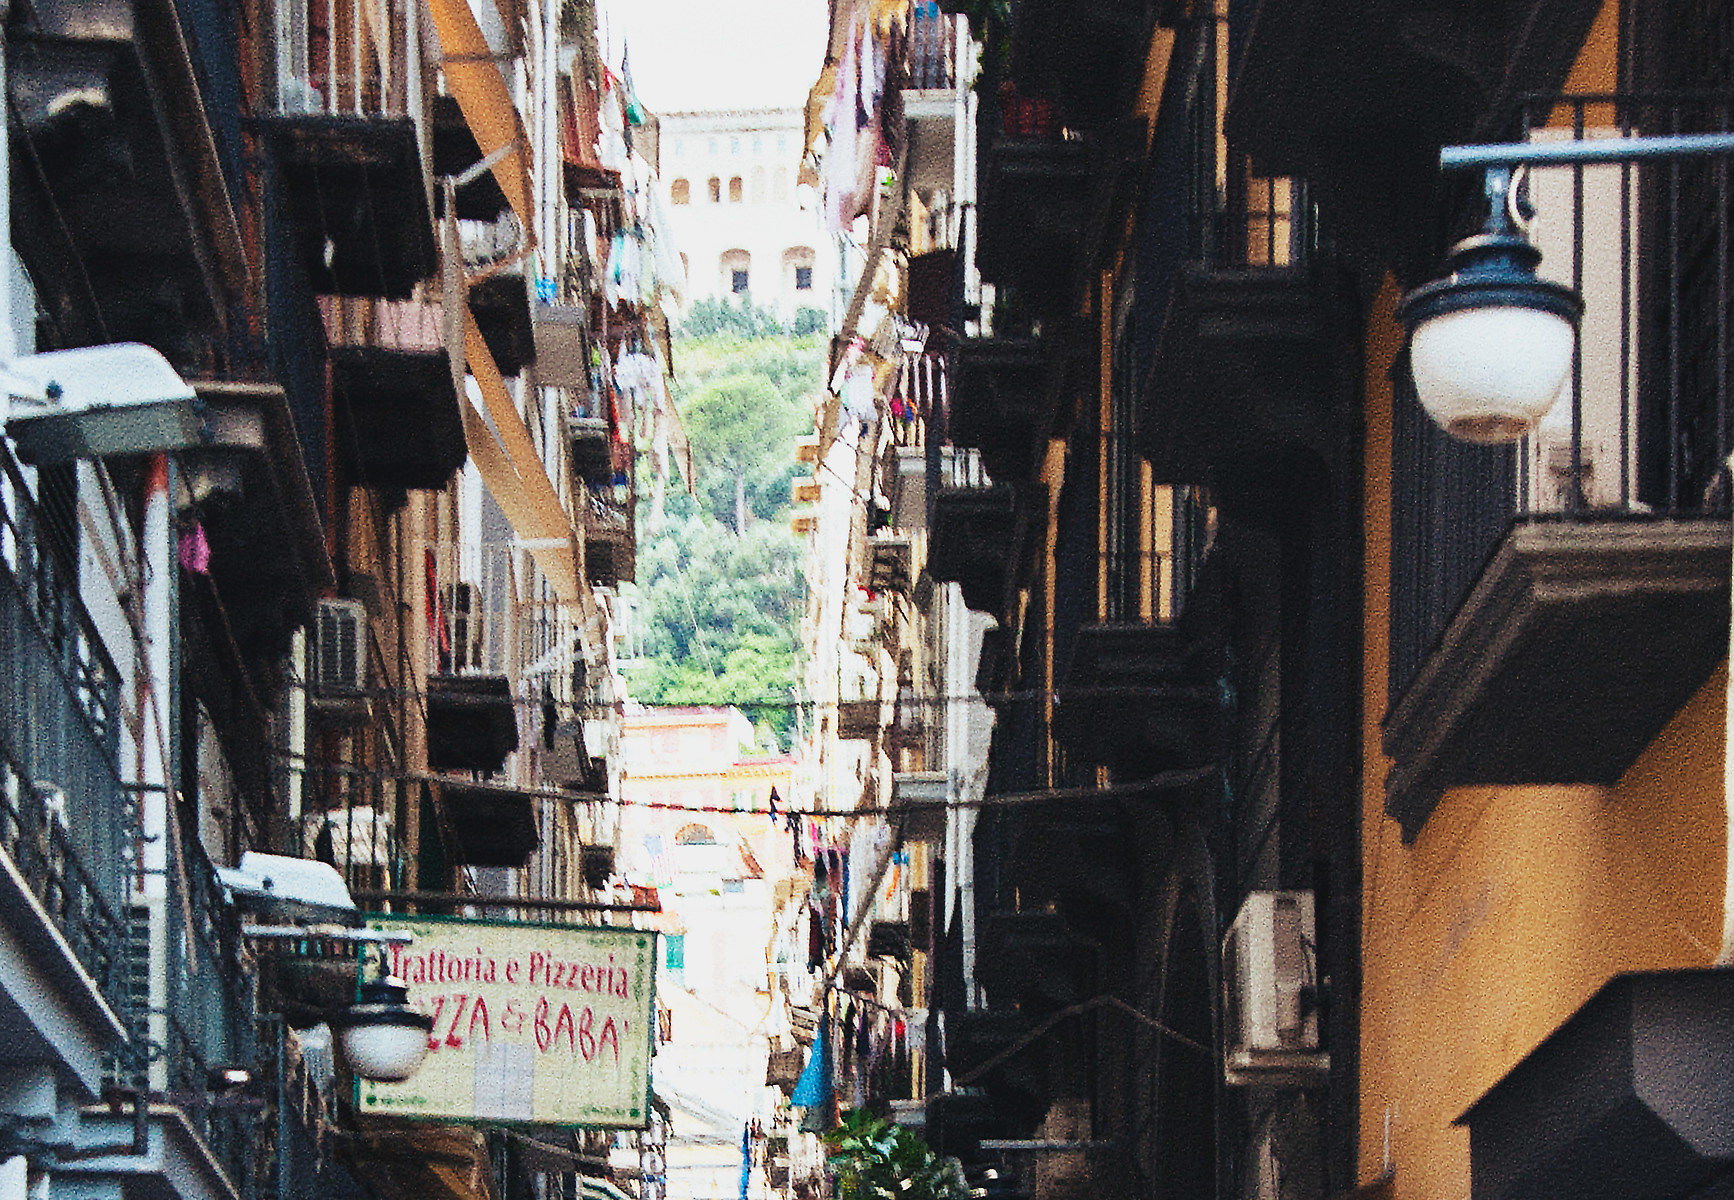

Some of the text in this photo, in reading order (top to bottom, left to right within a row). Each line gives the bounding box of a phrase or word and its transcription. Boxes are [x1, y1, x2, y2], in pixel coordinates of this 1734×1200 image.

[388, 943, 629, 999] Trattoria e Pizzeria
[413, 993, 491, 1053] ZZA
